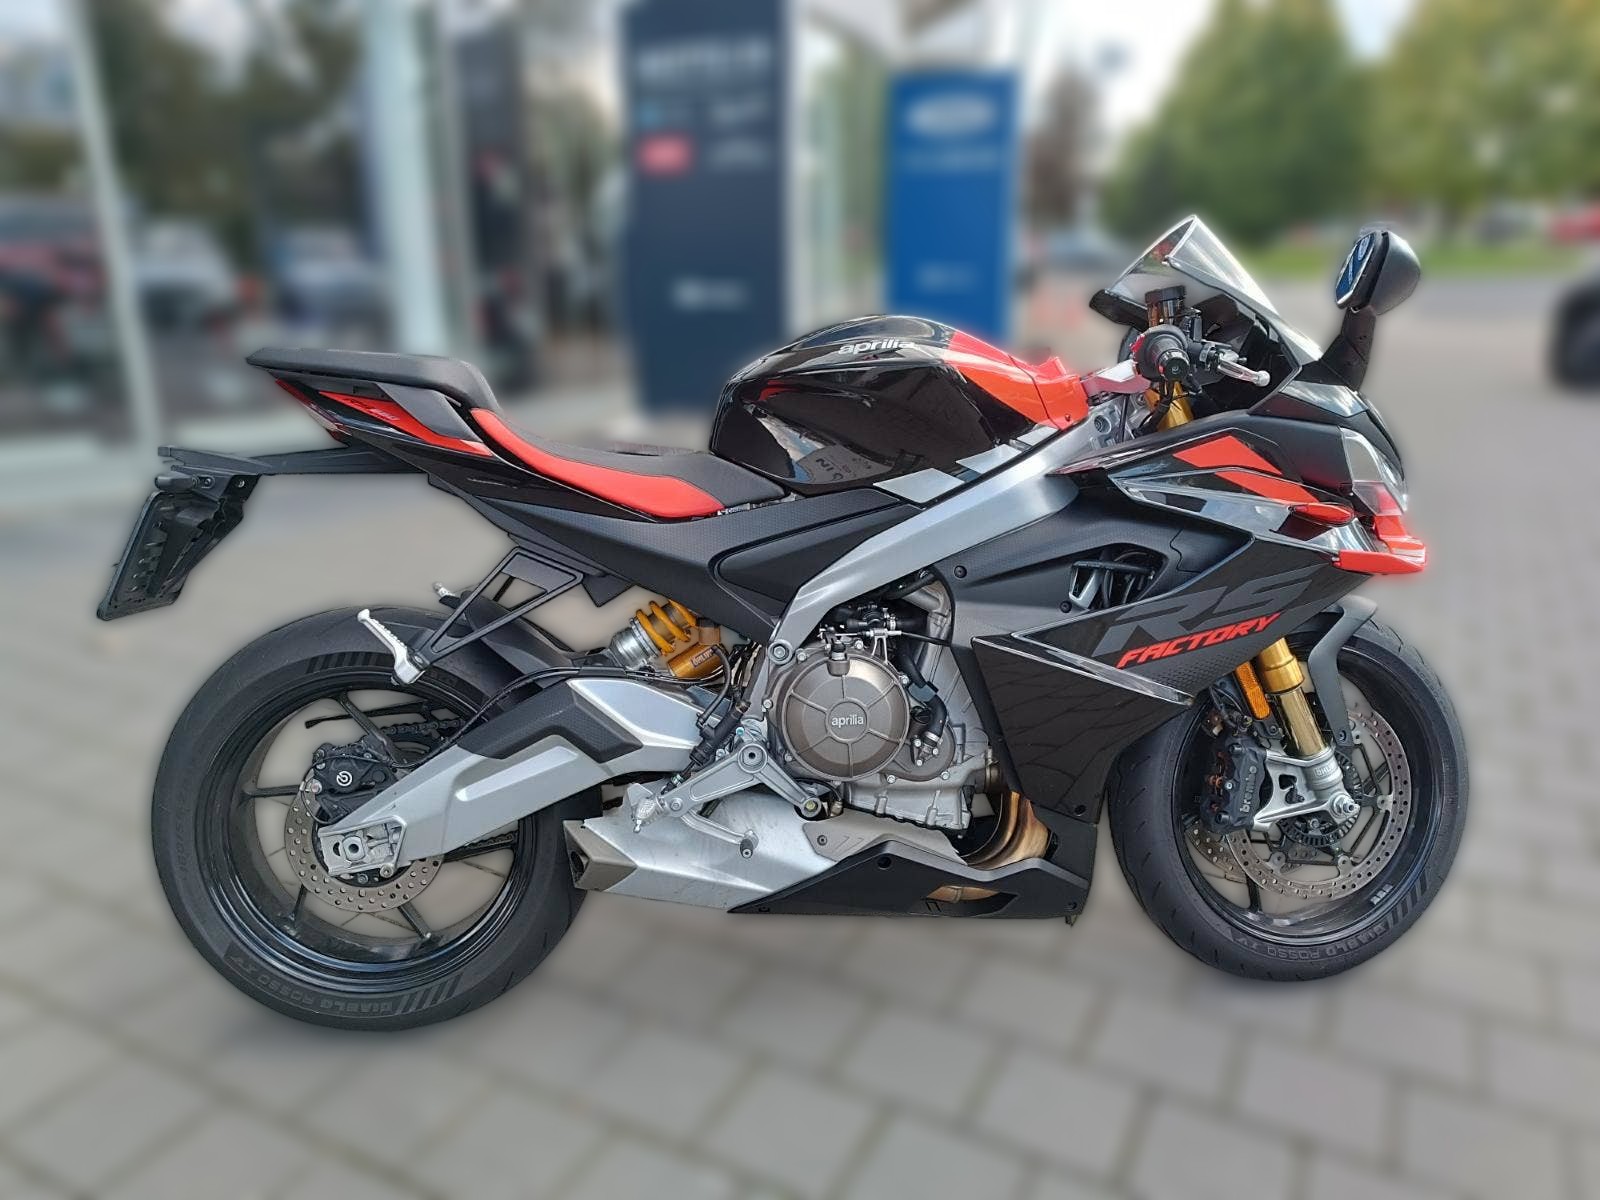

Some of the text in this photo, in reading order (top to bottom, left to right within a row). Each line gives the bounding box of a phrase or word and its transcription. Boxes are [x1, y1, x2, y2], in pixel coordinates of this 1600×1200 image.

[838, 338, 915, 355] aprilia
[1092, 562, 1330, 657] RS
[1116, 613, 1281, 669] FACTORY
[831, 714, 864, 728] aprilia
[1325, 923, 1387, 956] DIABLO
[1266, 945, 1320, 960] ROSSO
[320, 999, 393, 1013] DIABLO
